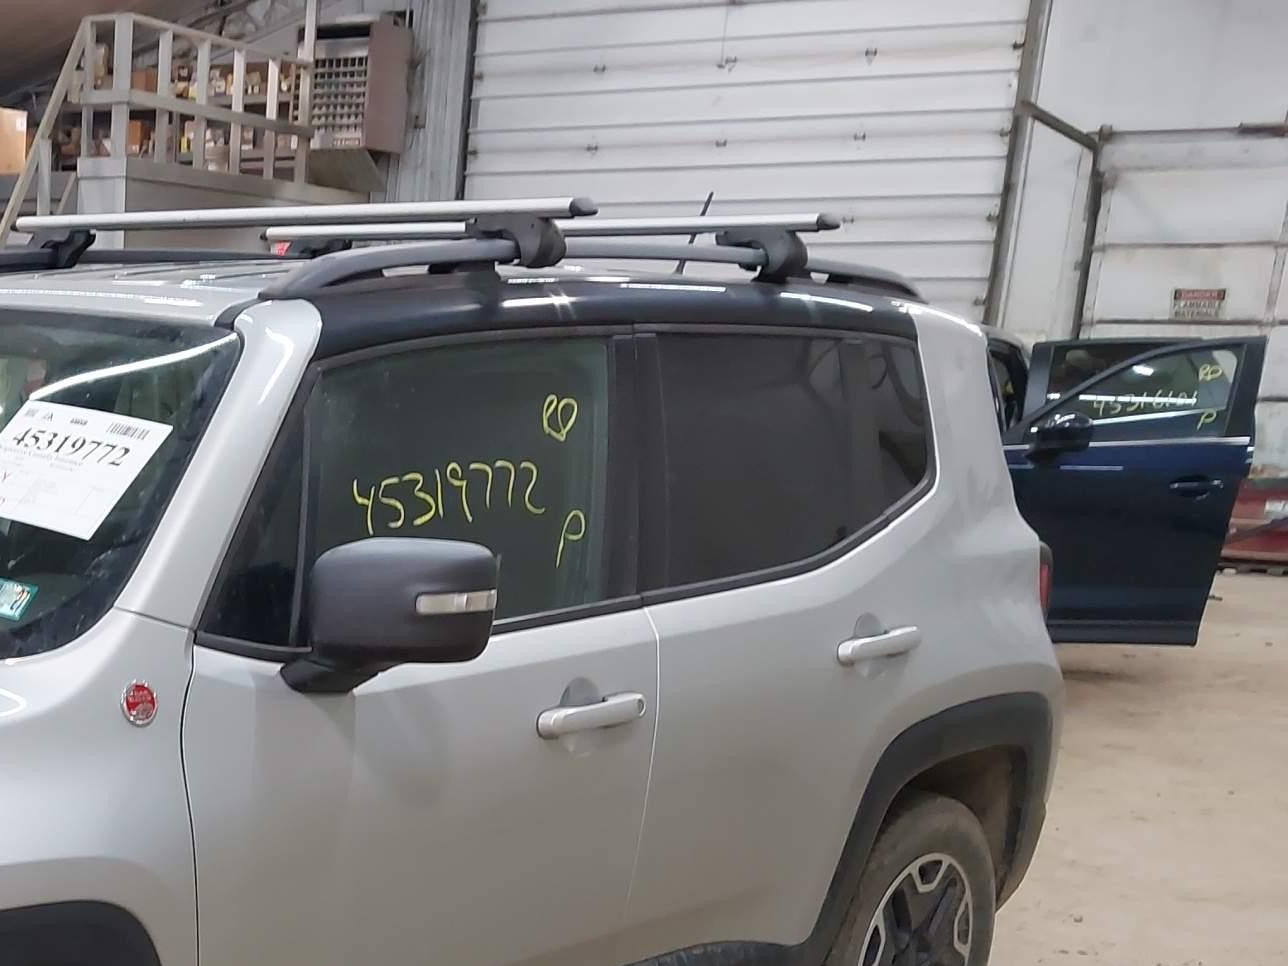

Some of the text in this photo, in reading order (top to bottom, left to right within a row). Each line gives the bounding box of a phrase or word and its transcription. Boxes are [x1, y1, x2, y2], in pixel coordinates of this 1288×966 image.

[12, 427, 131, 467] 45319772
[352, 459, 546, 536] 45319772
[554, 508, 587, 569] P
